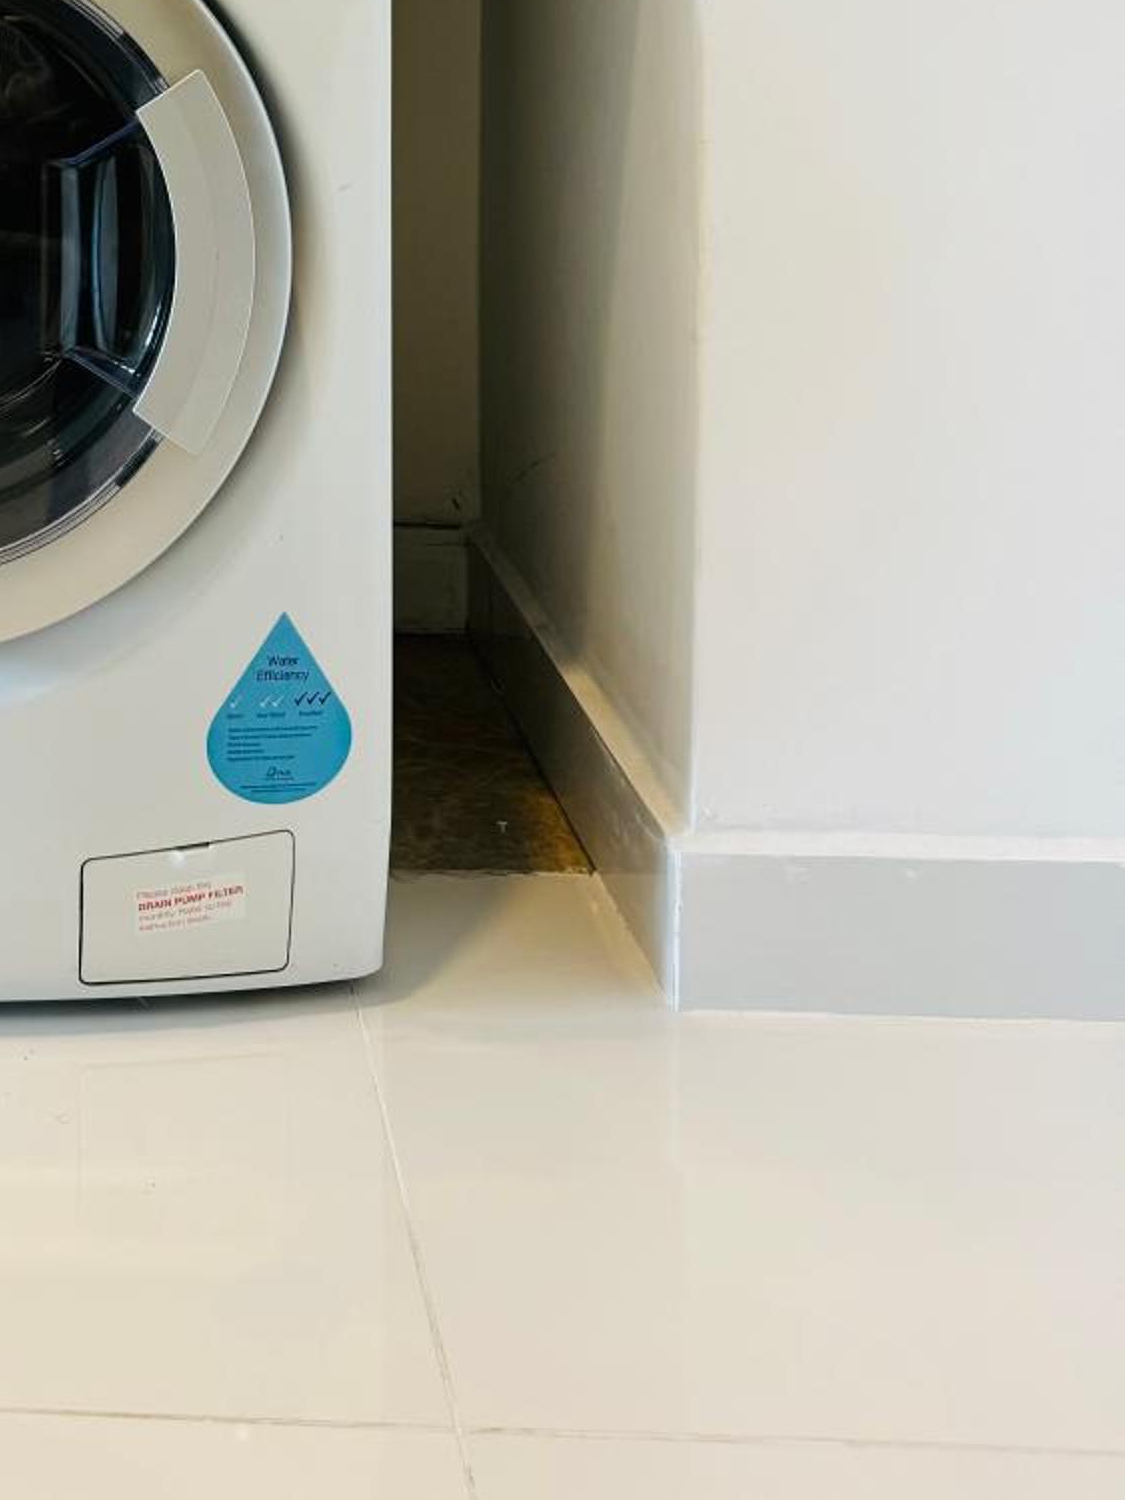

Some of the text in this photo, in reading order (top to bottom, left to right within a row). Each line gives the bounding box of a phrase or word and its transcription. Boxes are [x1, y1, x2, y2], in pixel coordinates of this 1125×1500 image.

[267, 655, 299, 666] Water
[256, 670, 310, 683] Efficiency
[138, 899, 172, 912] DRAIN
[174, 892, 206, 905] PUMP
[208, 885, 244, 898] FILTER
